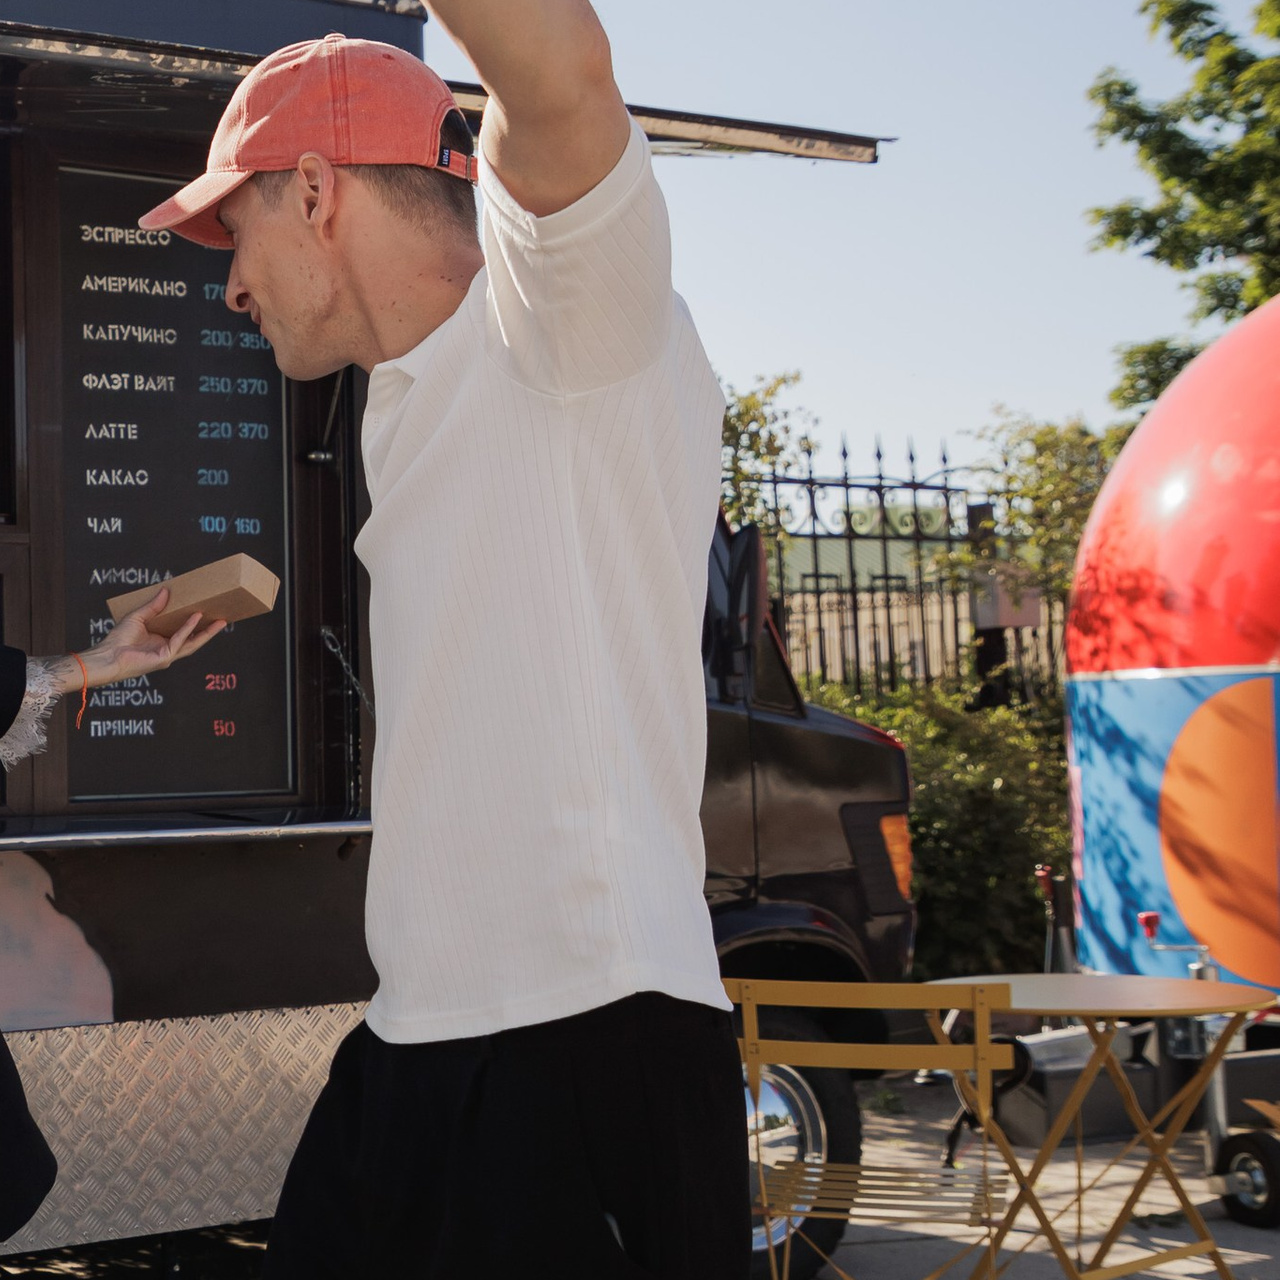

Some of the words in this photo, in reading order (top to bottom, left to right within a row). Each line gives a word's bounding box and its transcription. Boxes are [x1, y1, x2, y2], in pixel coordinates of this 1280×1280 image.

[79, 225, 171, 246] ЭСПРЕССО
[81, 274, 188, 297] АМЕРИКАНО
[82, 324, 178, 345] КАПУЧИНО
[82, 373, 130, 391] ФЛЭТ
[134, 375, 175, 392] ВАЙТ
[85, 423, 138, 439] ЛАТТЕ
[86, 469, 149, 486] КАКАО
[197, 469, 229, 486] 200
[87, 517, 122, 533] ЧАЙ
[205, 673, 237, 691] 250
[89, 688, 163, 707] АПЕРОЛЬ
[90, 719, 154, 737] ПРЯНИК
[213, 720, 236, 737] 50
